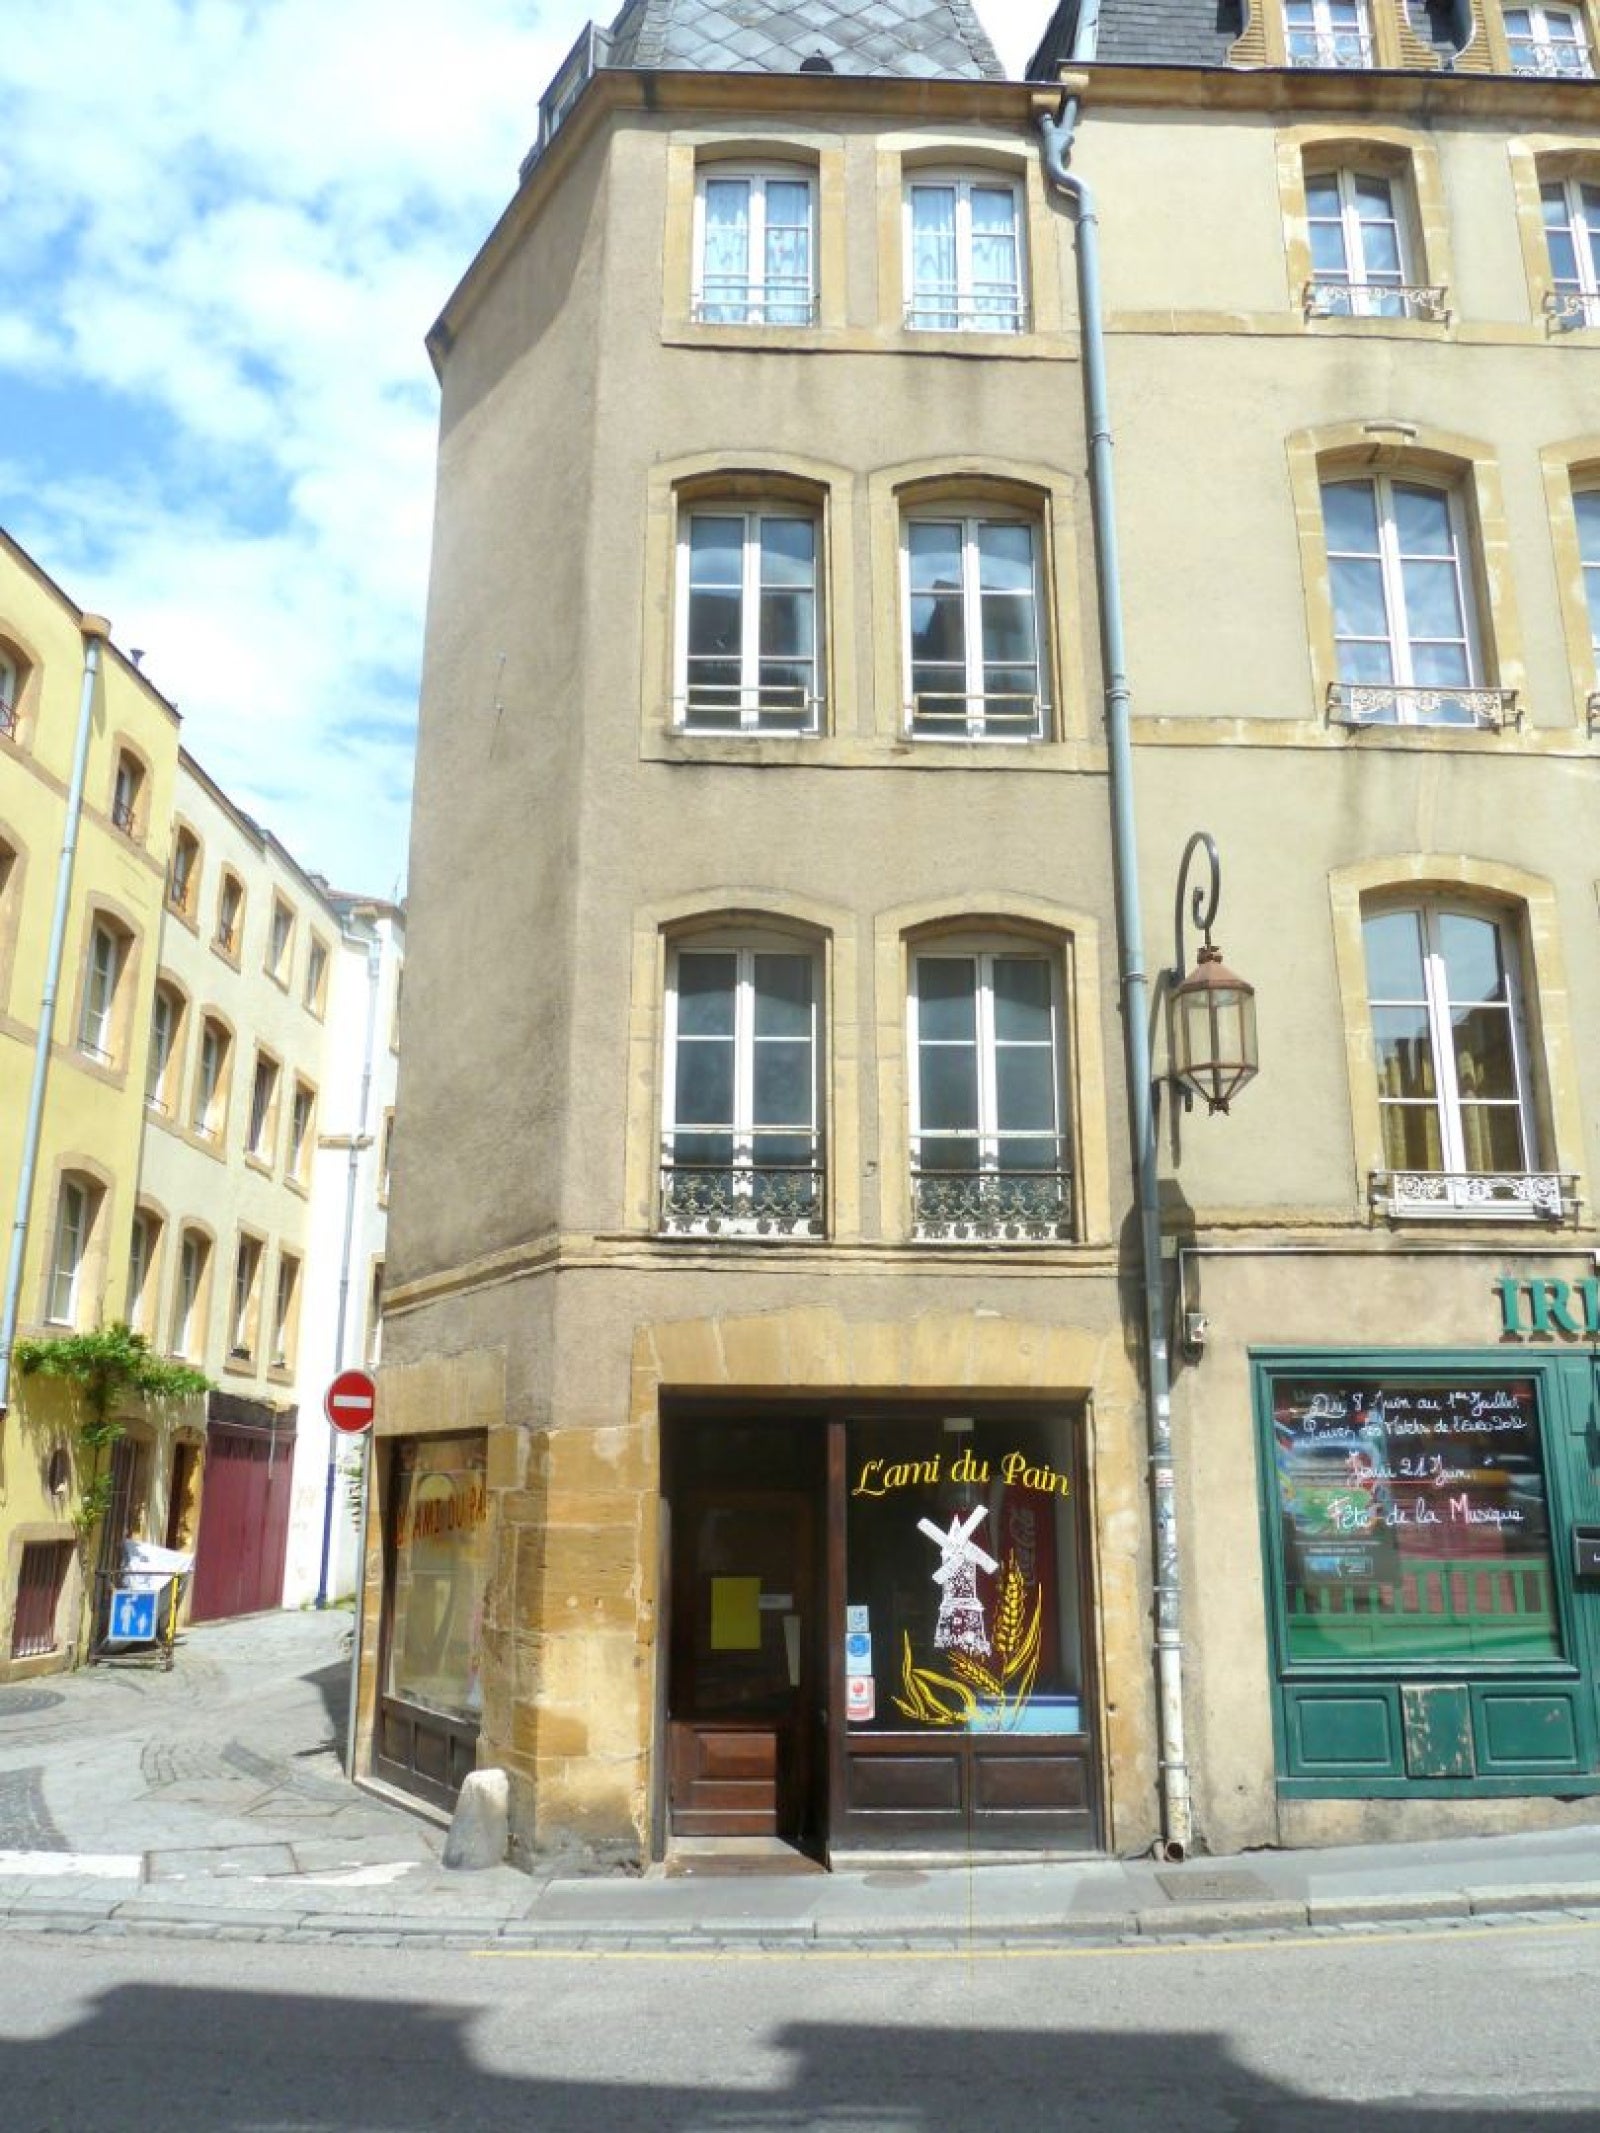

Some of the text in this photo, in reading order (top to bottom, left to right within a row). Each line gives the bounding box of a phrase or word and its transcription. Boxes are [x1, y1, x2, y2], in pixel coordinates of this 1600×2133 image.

[1303, 1393, 1345, 1419] Du
[1417, 1398, 1441, 1410] au
[1433, 1418, 1451, 1433] de
[851, 1450, 1069, 1496] L'ami du Pain
[1399, 1456, 1428, 1477] 21
[1387, 1505, 1410, 1525] de
[1416, 1497, 1441, 1523] la
[1450, 1493, 1524, 1531] Musique
